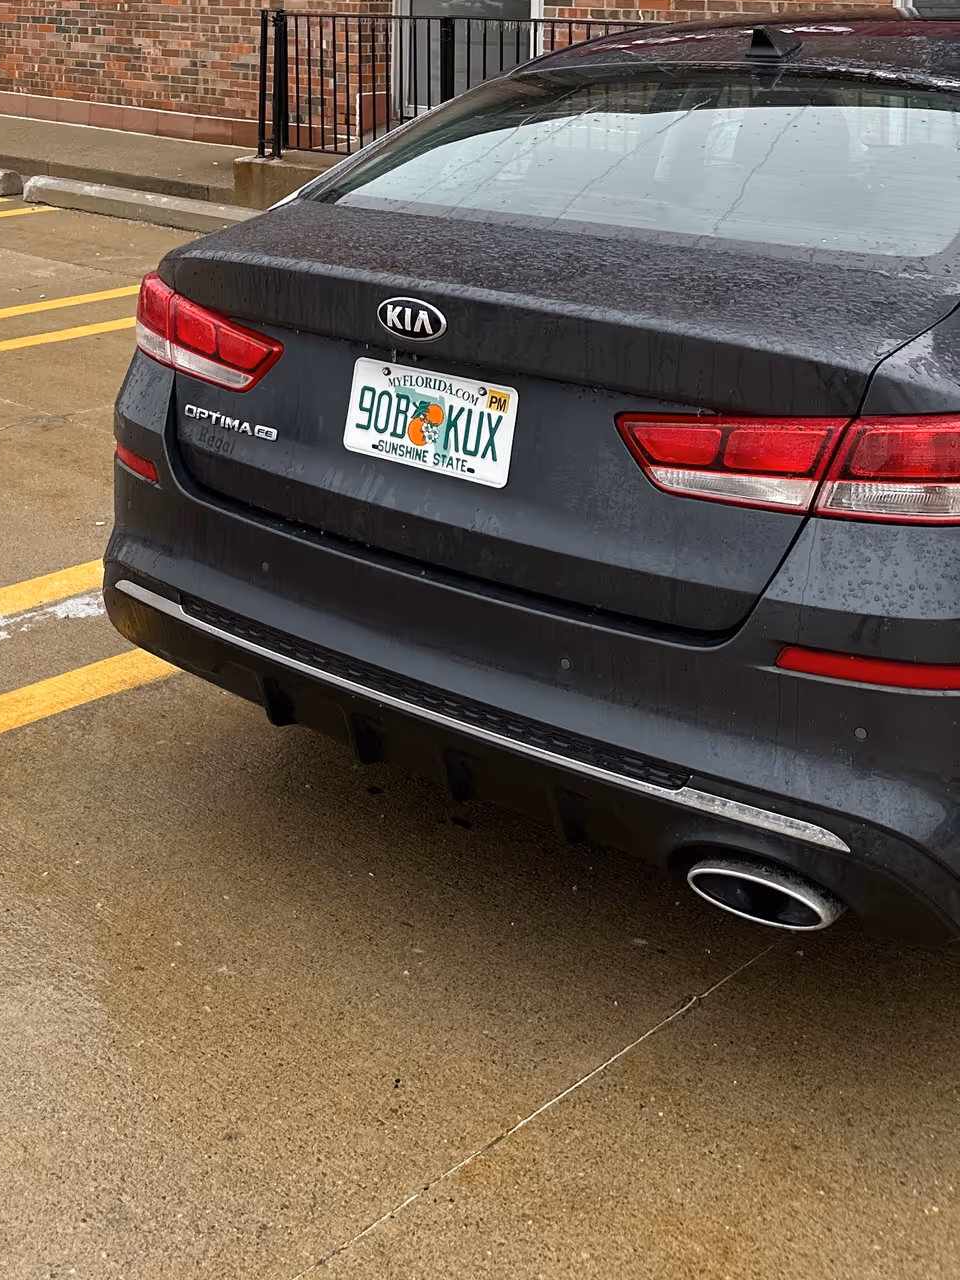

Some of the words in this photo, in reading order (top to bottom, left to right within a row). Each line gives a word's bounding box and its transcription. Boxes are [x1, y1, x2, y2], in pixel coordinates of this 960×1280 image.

[386, 304, 433, 334] KIA
[388, 375, 480, 406] MYFLORIDA.COM
[489, 395, 507, 412] PM
[184, 403, 253, 436] OPTIMA
[256, 427, 275, 439] FE
[356, 386, 411, 439] 90B
[443, 404, 503, 462] KUX
[377, 439, 429, 463] SUNSHINE
[433, 453, 468, 473] STATE
